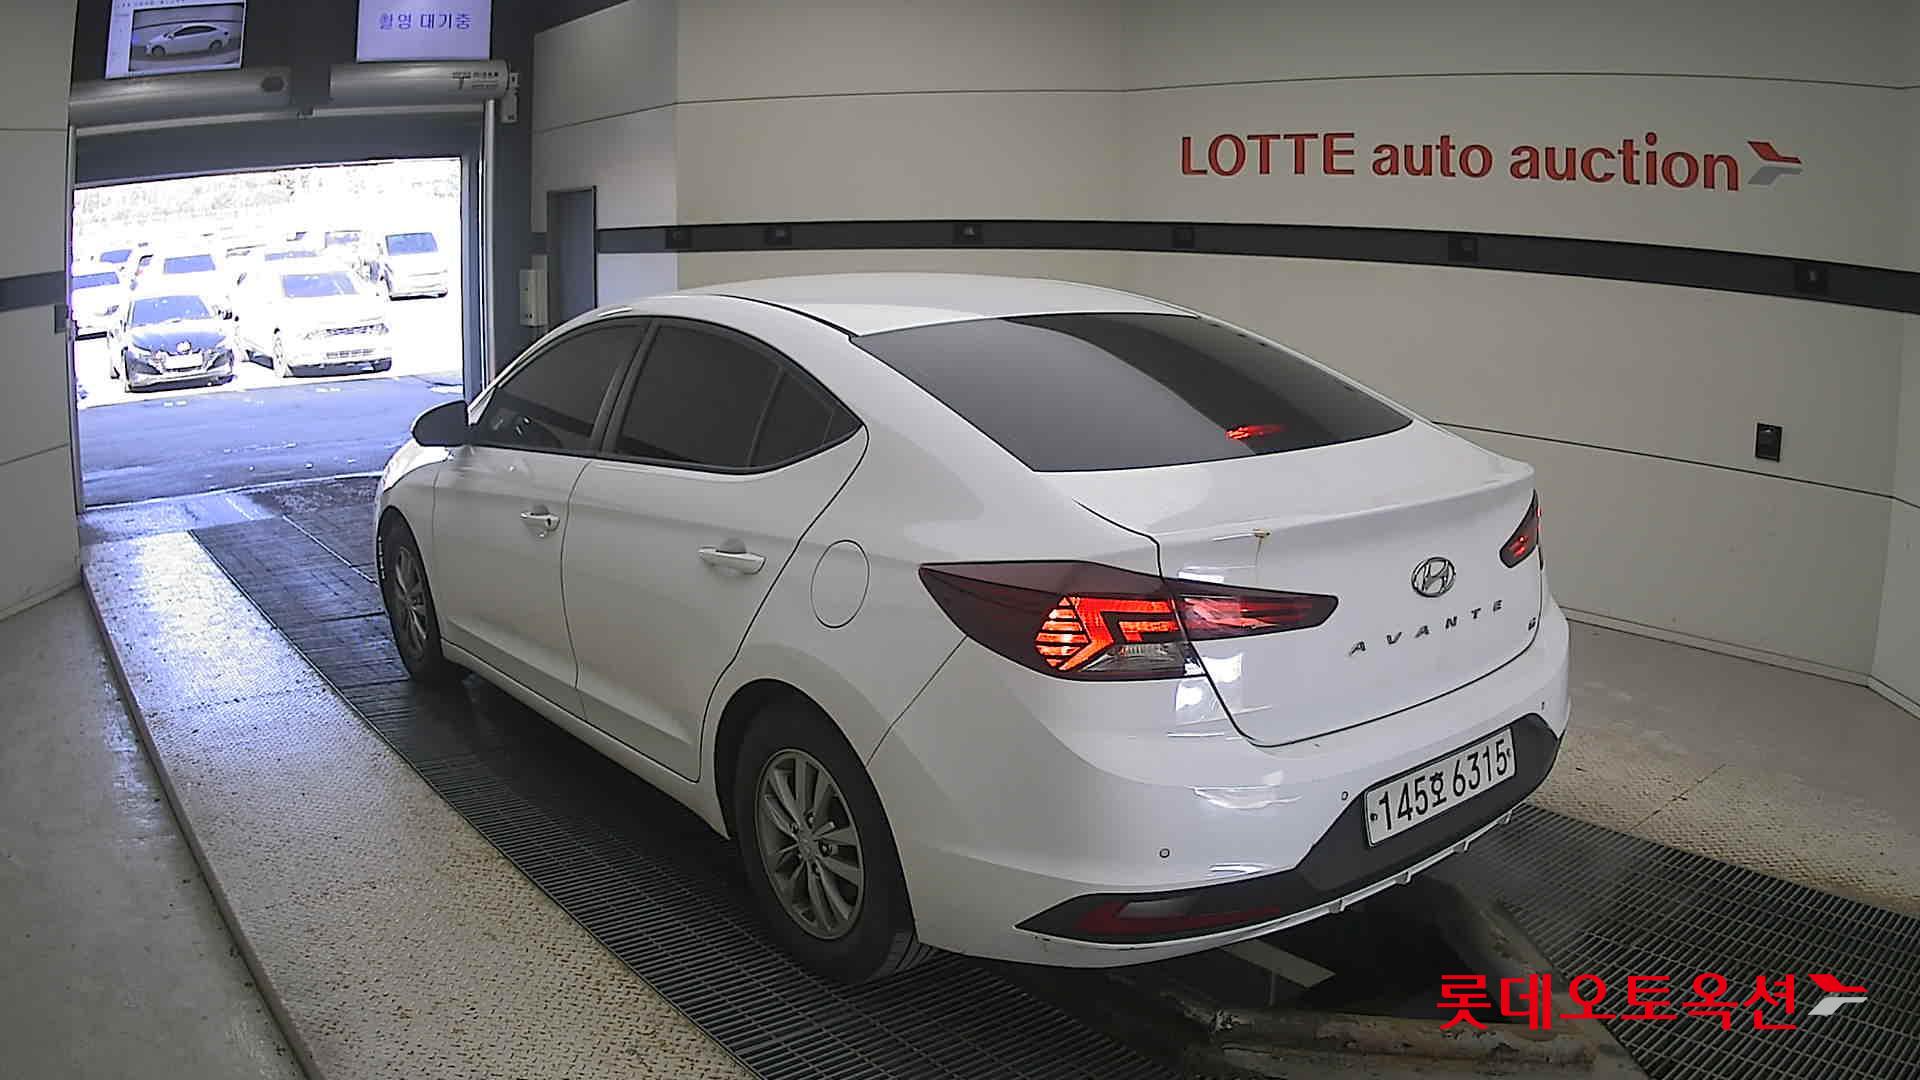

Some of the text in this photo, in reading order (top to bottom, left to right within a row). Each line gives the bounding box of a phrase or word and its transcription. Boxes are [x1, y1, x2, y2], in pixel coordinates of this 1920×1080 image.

[420, 13, 472, 30] 대기중
[1181, 132, 1740, 192] LOTTE auto auction
[1348, 599, 1504, 657] AVANTE
[1378, 738, 1508, 831] 145호 6315
